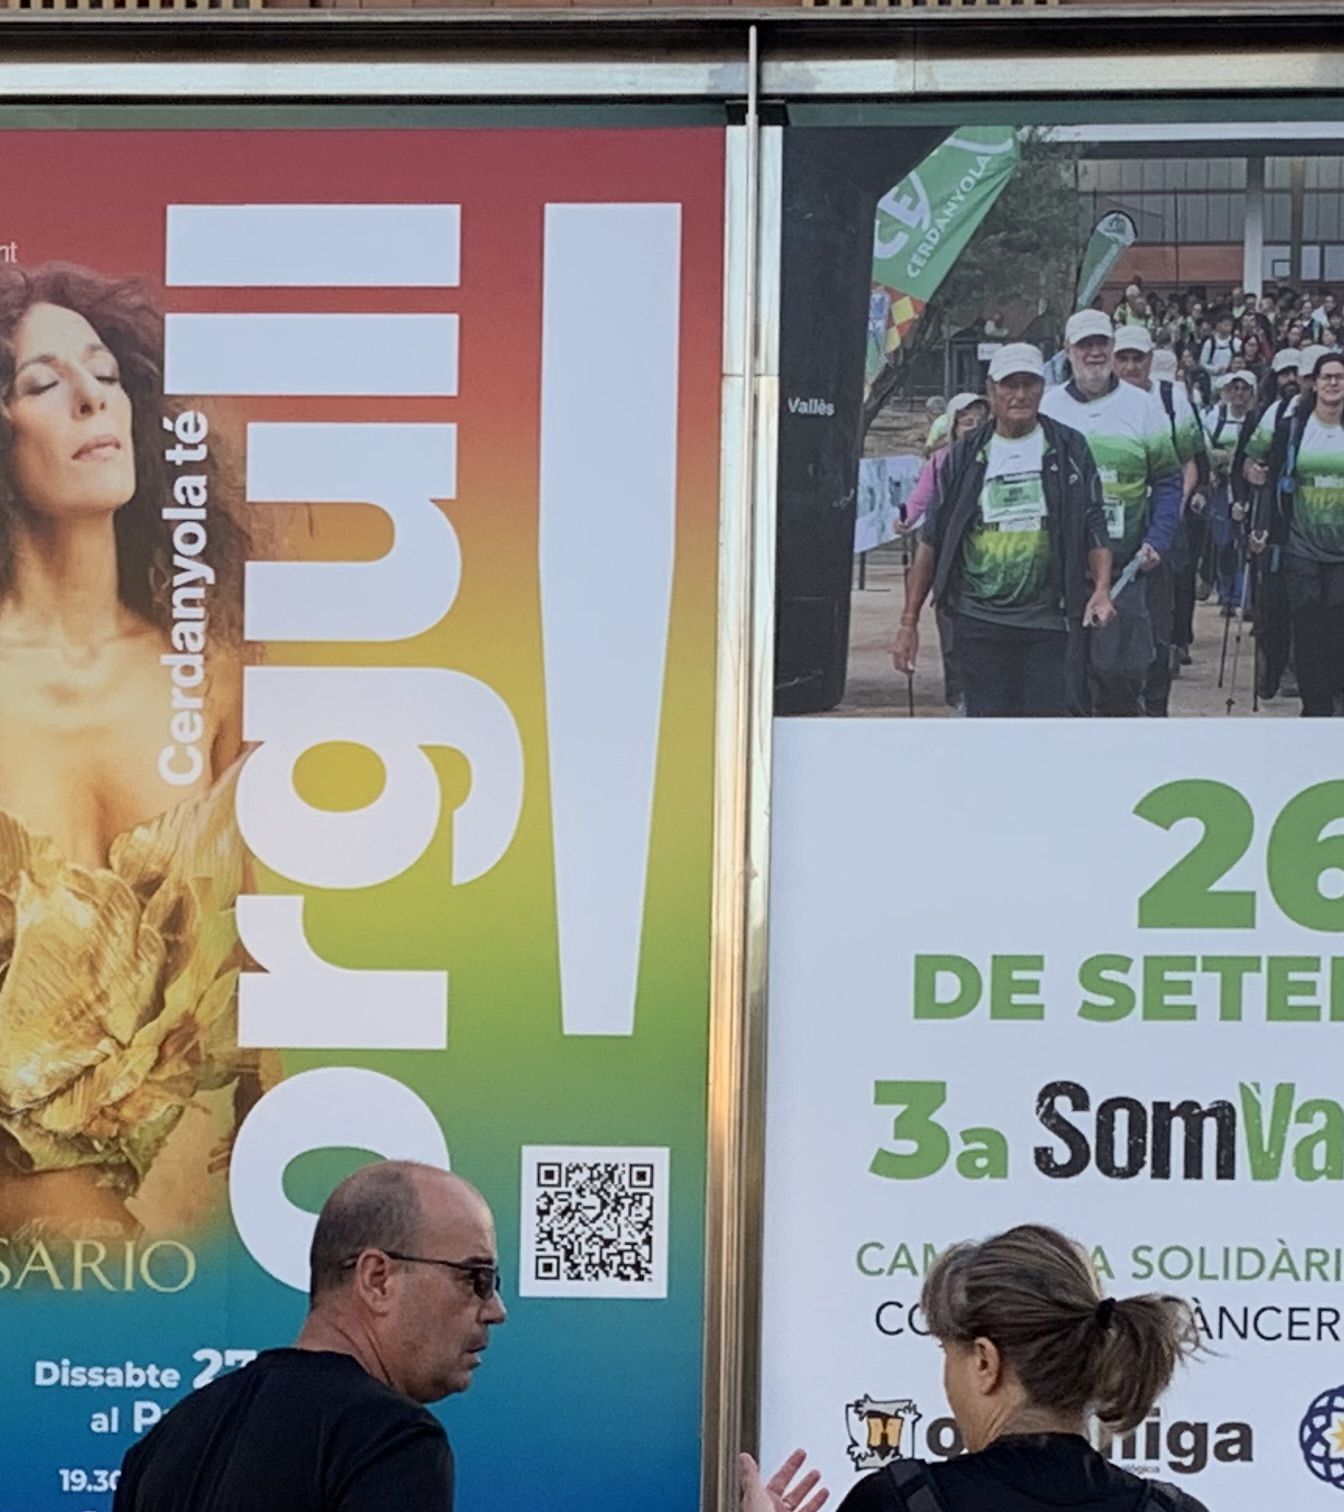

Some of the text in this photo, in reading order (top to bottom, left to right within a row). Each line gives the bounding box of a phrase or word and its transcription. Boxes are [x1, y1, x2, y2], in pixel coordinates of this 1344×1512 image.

[906, 154, 992, 278] CERDANYOLA
[787, 397, 835, 417] Vallès
[158, 410, 214, 786] Cerdanyola té
[164, 203, 525, 1294] orgull
[913, 954, 1045, 1021] DE
[868, 1080, 1009, 1181] 3a
[34, 1358, 181, 1389] Dissabte
[90, 1407, 119, 1433] al
